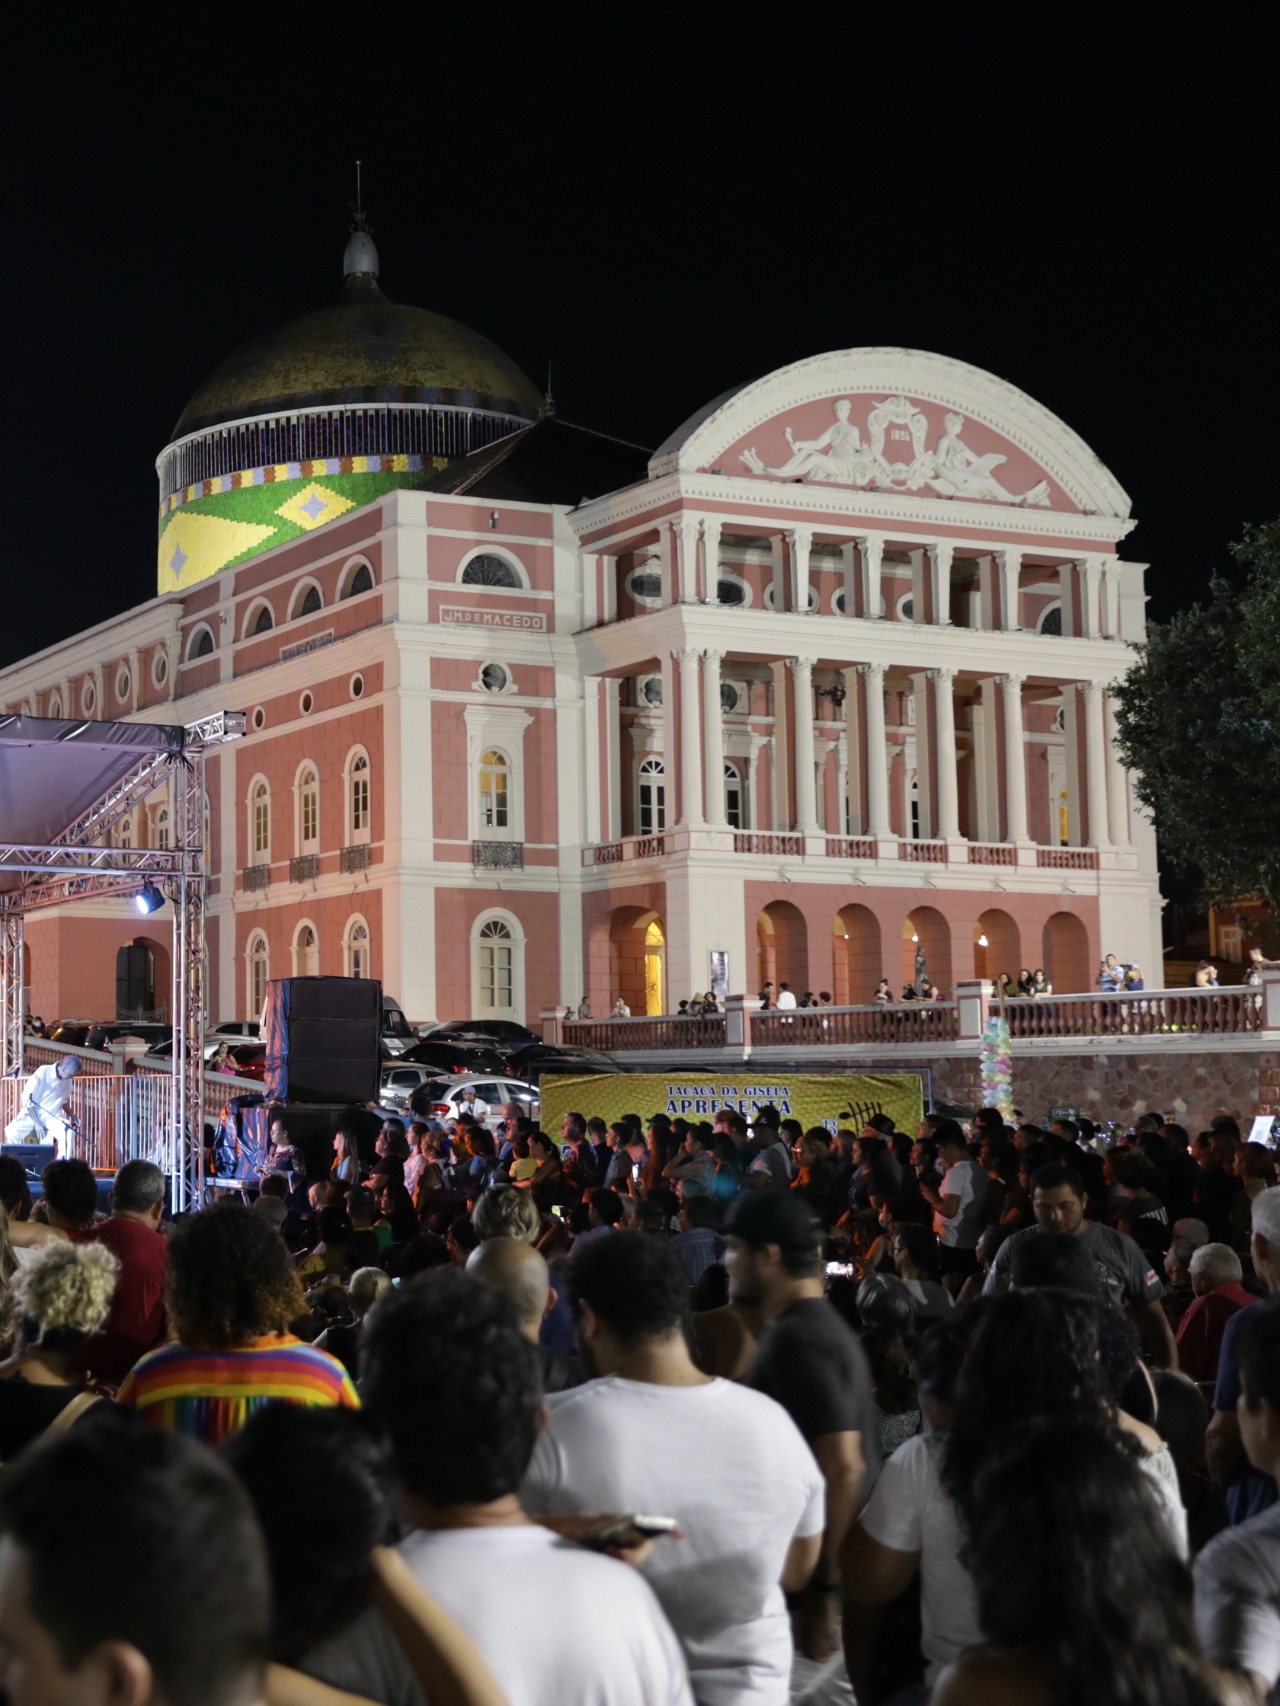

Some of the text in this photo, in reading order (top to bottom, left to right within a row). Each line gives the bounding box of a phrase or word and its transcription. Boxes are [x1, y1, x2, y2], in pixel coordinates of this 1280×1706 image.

[465, 613, 480, 622] DE
[483, 614, 541, 628] MACEDO
[667, 1084, 790, 1096] TACACÁ DA GISELA
